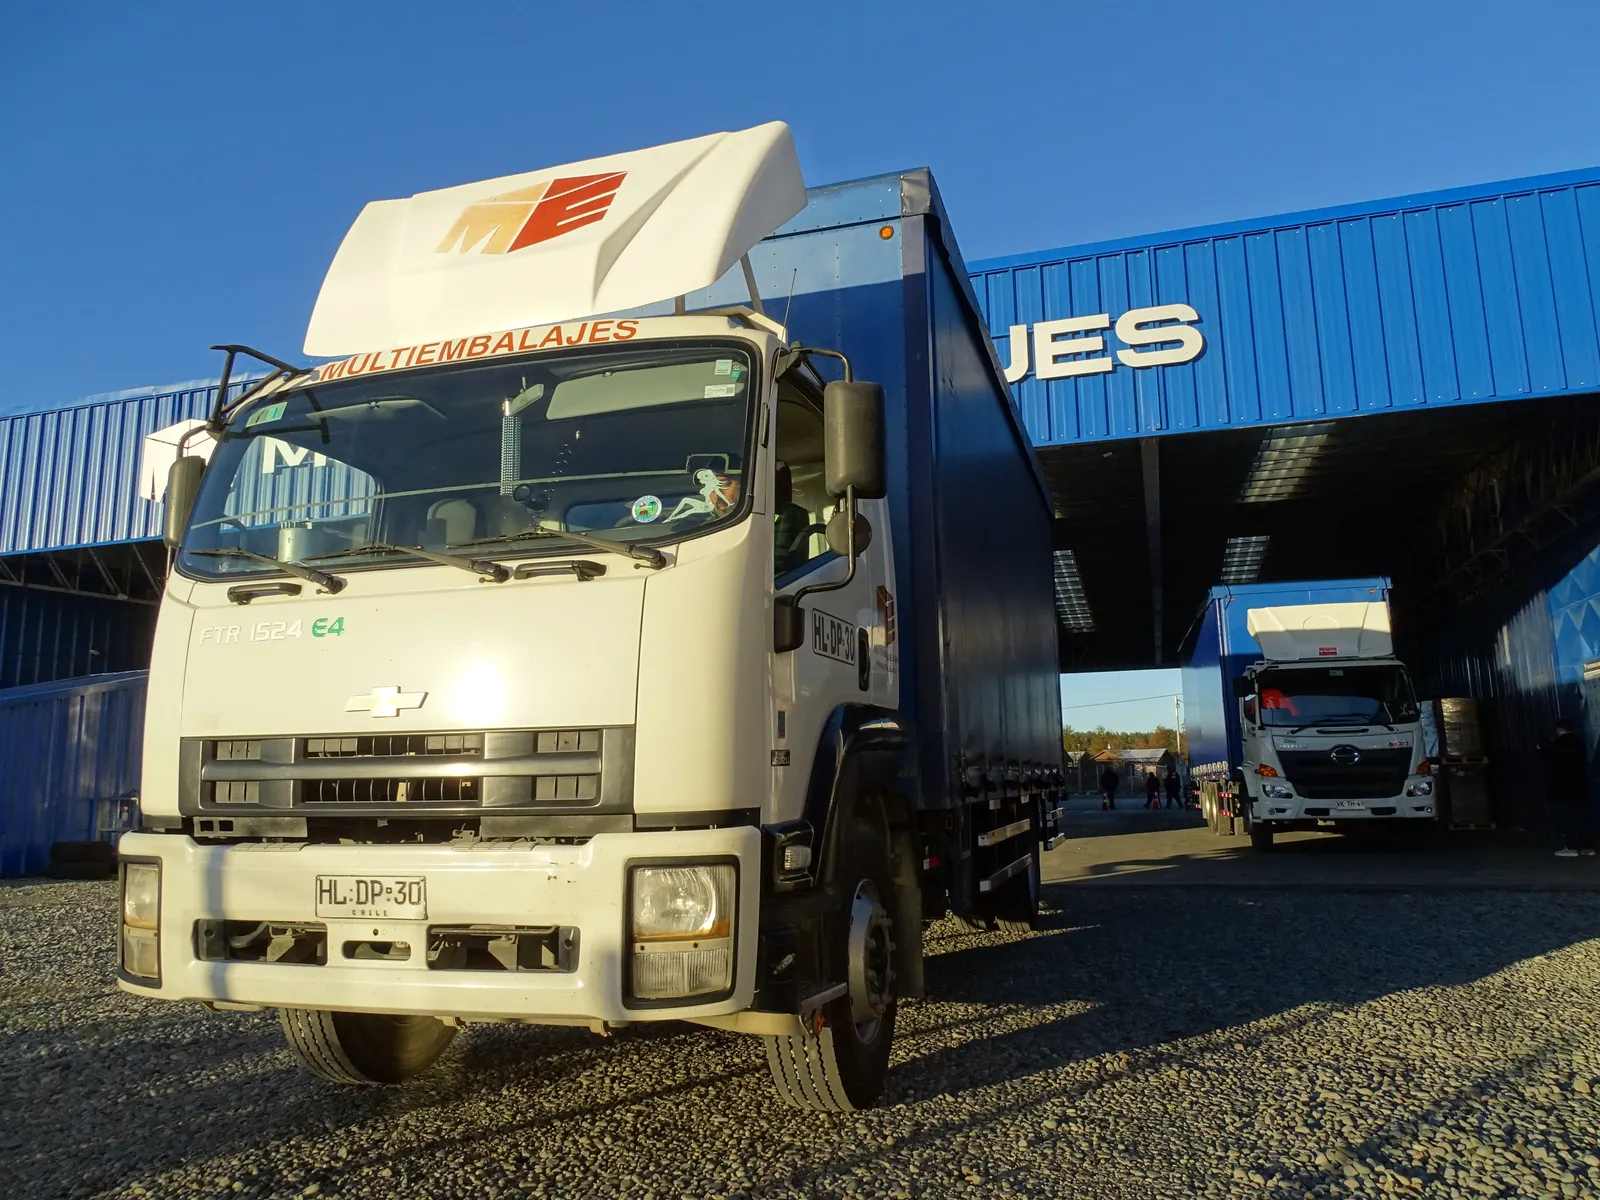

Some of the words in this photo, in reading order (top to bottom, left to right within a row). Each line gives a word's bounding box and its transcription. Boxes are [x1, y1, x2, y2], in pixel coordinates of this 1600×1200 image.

[319, 320, 639, 381] MULTIEMBALAJES
[200, 624, 242, 646] FTR
[250, 619, 304, 642] 1524
[311, 616, 345, 638] E4
[352, 909, 388, 917] CHILE
